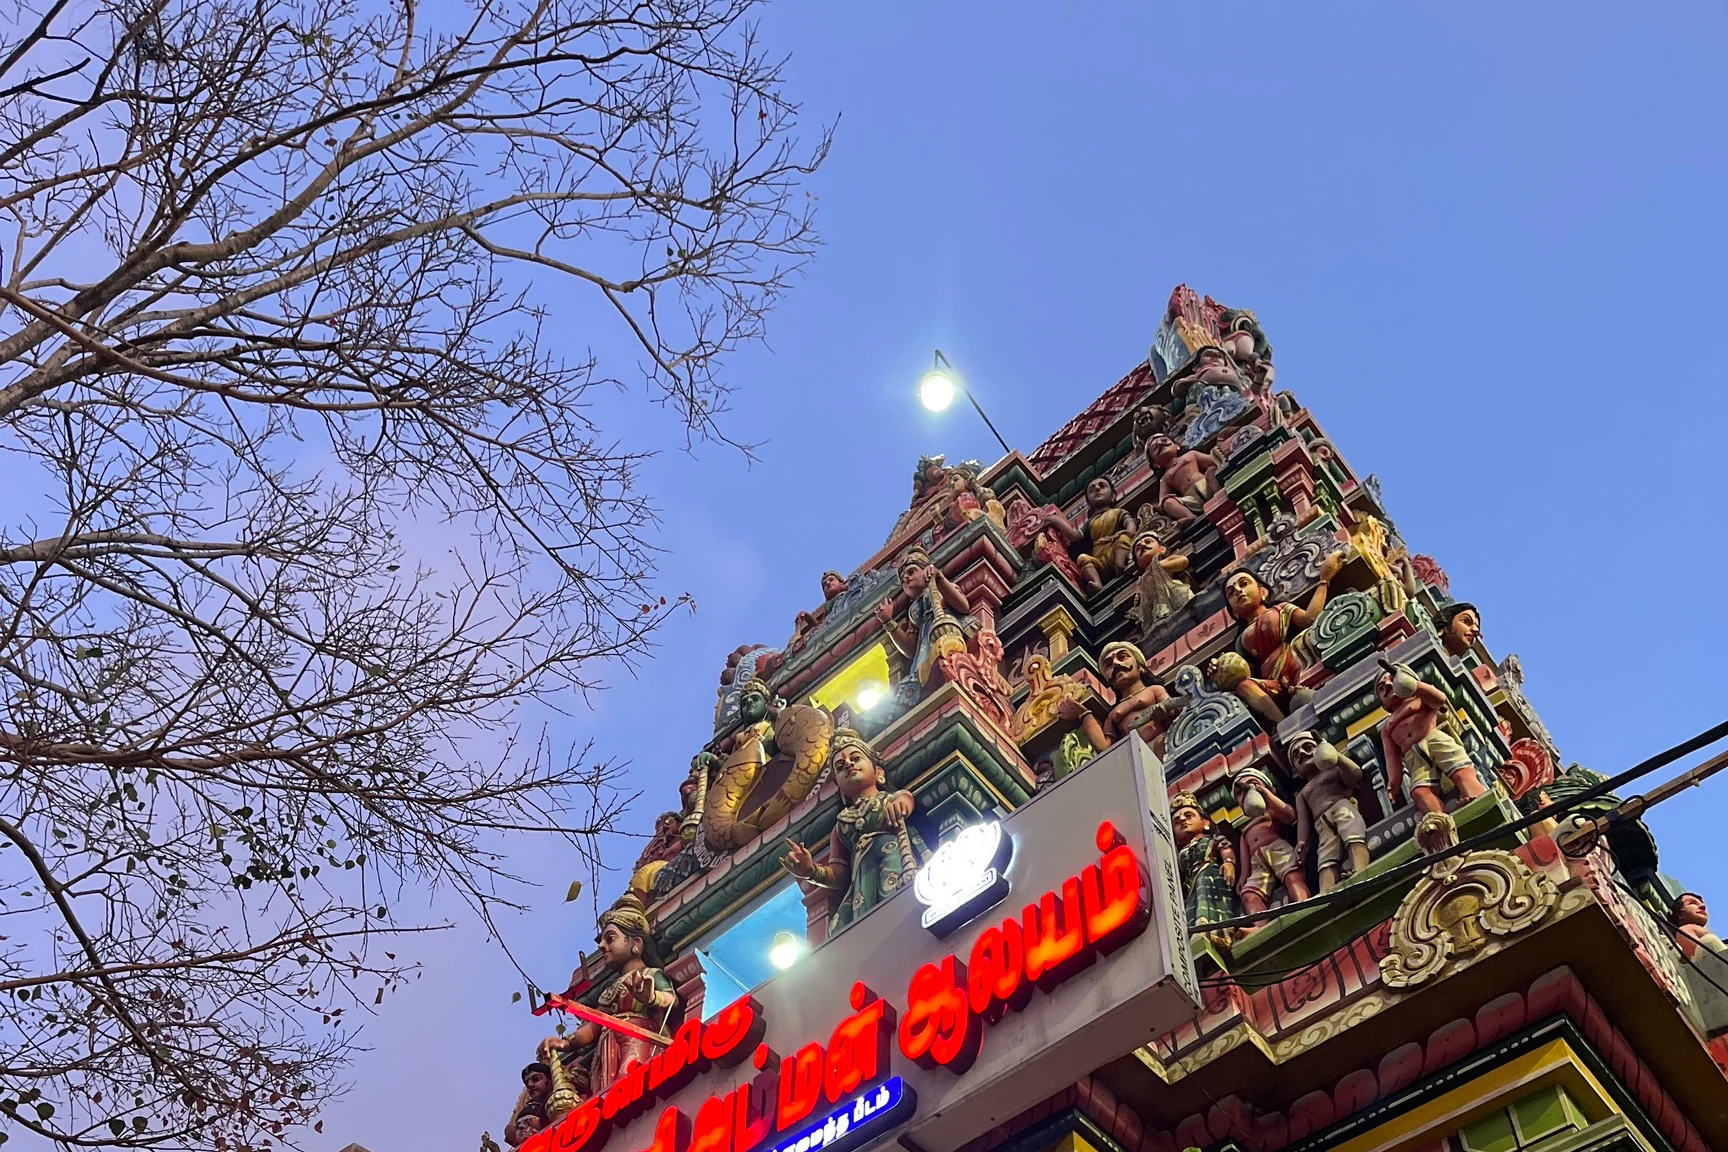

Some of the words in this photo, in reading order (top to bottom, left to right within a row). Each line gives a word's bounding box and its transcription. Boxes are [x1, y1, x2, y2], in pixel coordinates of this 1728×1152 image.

[1163, 860, 1179, 905] PANEL
[898, 820, 1139, 1065] ஆலயம்
[1171, 903, 1194, 997] COMPOSITE
[853, 1084, 890, 1123] பீடம்
